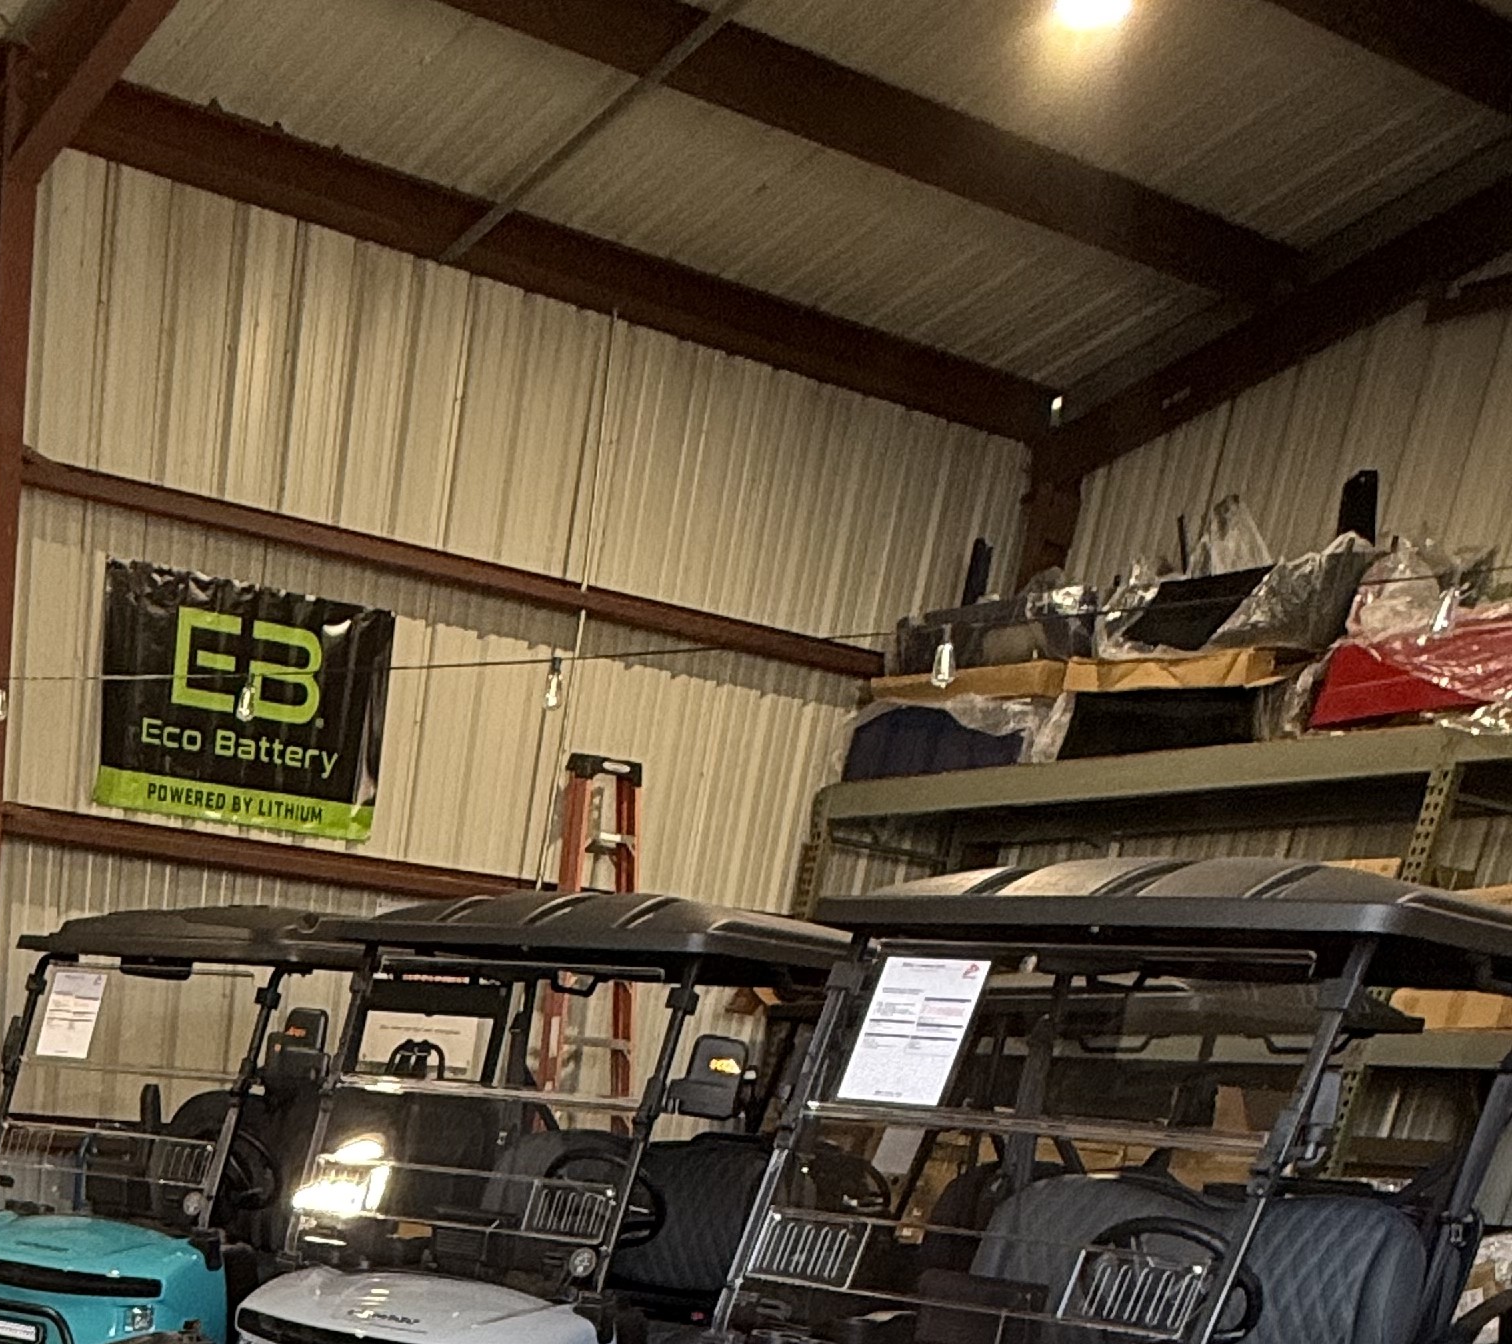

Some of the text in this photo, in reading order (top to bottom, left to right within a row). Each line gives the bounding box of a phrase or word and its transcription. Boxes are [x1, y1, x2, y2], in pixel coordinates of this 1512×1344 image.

[171, 605, 322, 725] EB
[141, 717, 338, 779] Eco Battery
[147, 782, 323, 823] POWERED BY LITHIUM
